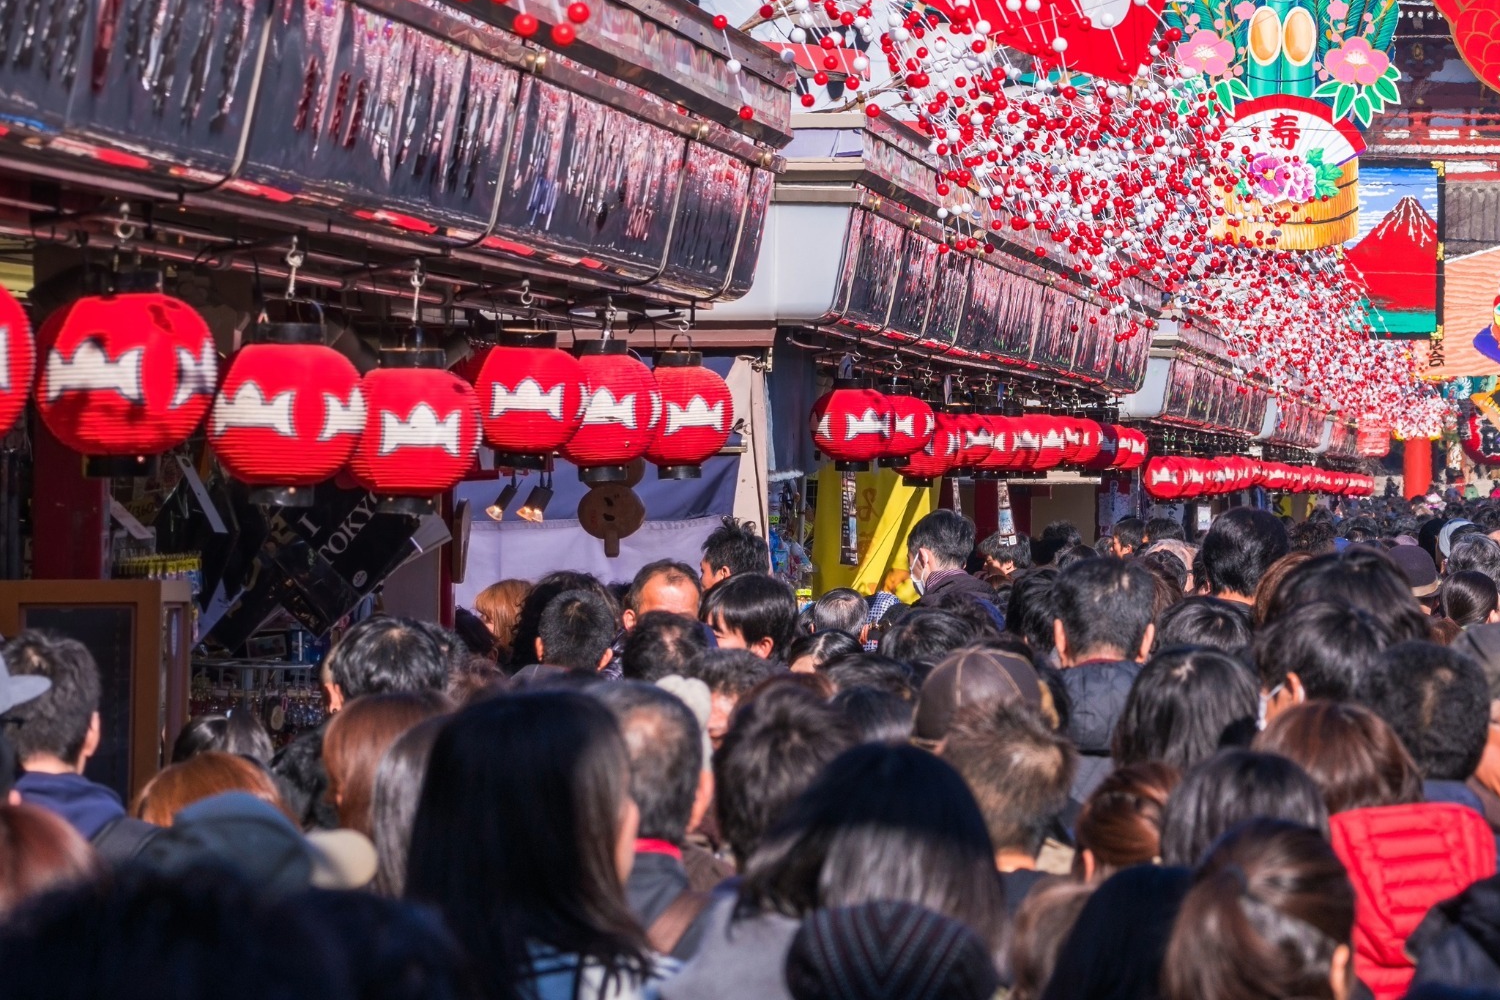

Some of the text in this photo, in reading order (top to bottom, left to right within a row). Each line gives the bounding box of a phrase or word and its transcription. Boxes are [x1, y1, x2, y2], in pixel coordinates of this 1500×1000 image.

[1267, 112, 1302, 151] 寿
[297, 512, 322, 538] I
[317, 490, 378, 565] TOKY
